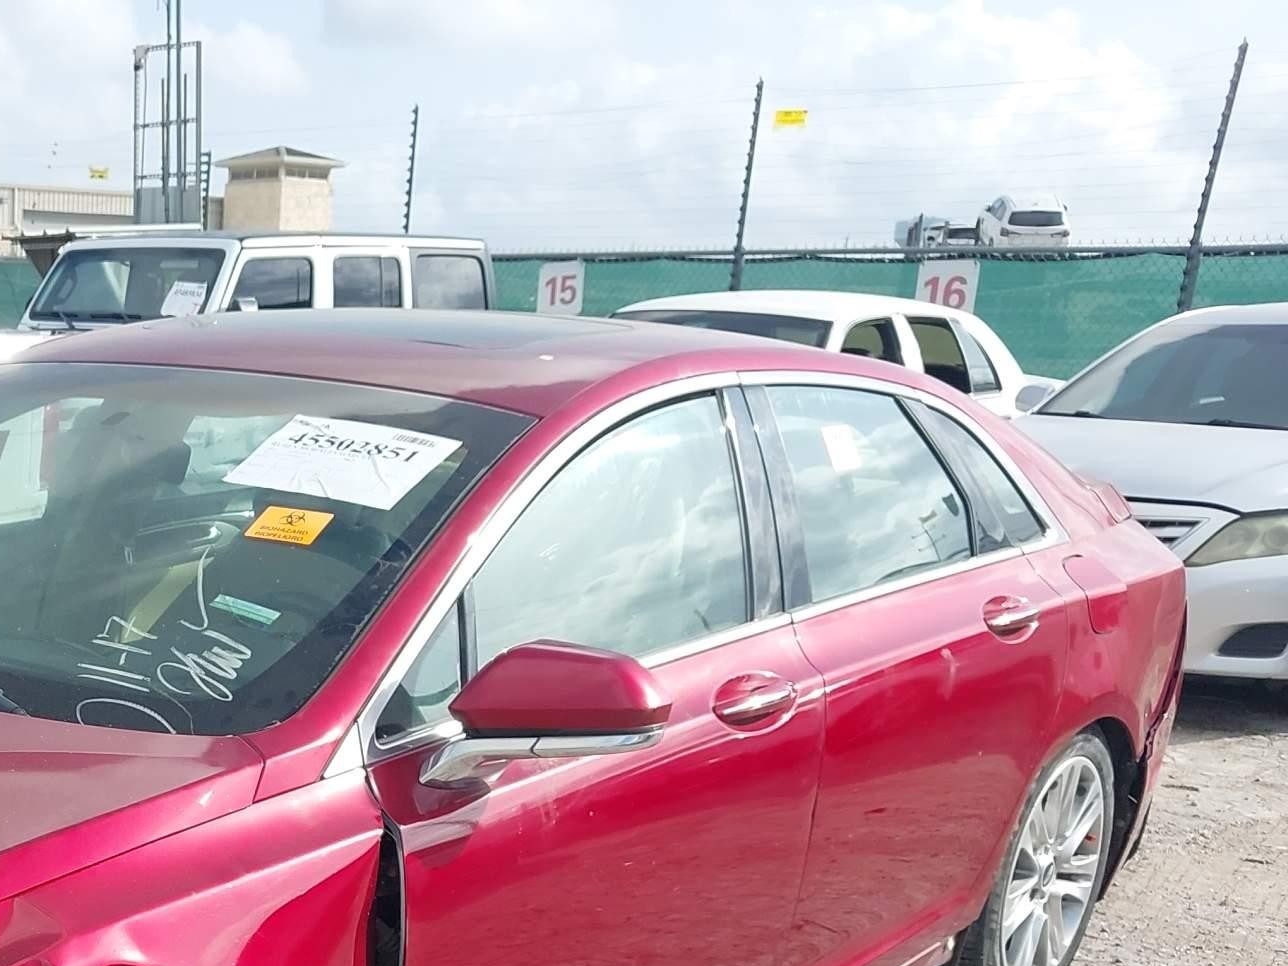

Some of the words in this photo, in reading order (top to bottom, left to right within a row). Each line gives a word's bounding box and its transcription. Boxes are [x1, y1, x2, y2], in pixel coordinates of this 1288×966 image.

[545, 274, 577, 307] 15
[923, 275, 968, 309] 16
[288, 431, 419, 464] 45502851
[259, 525, 309, 536] BIOHAZARD
